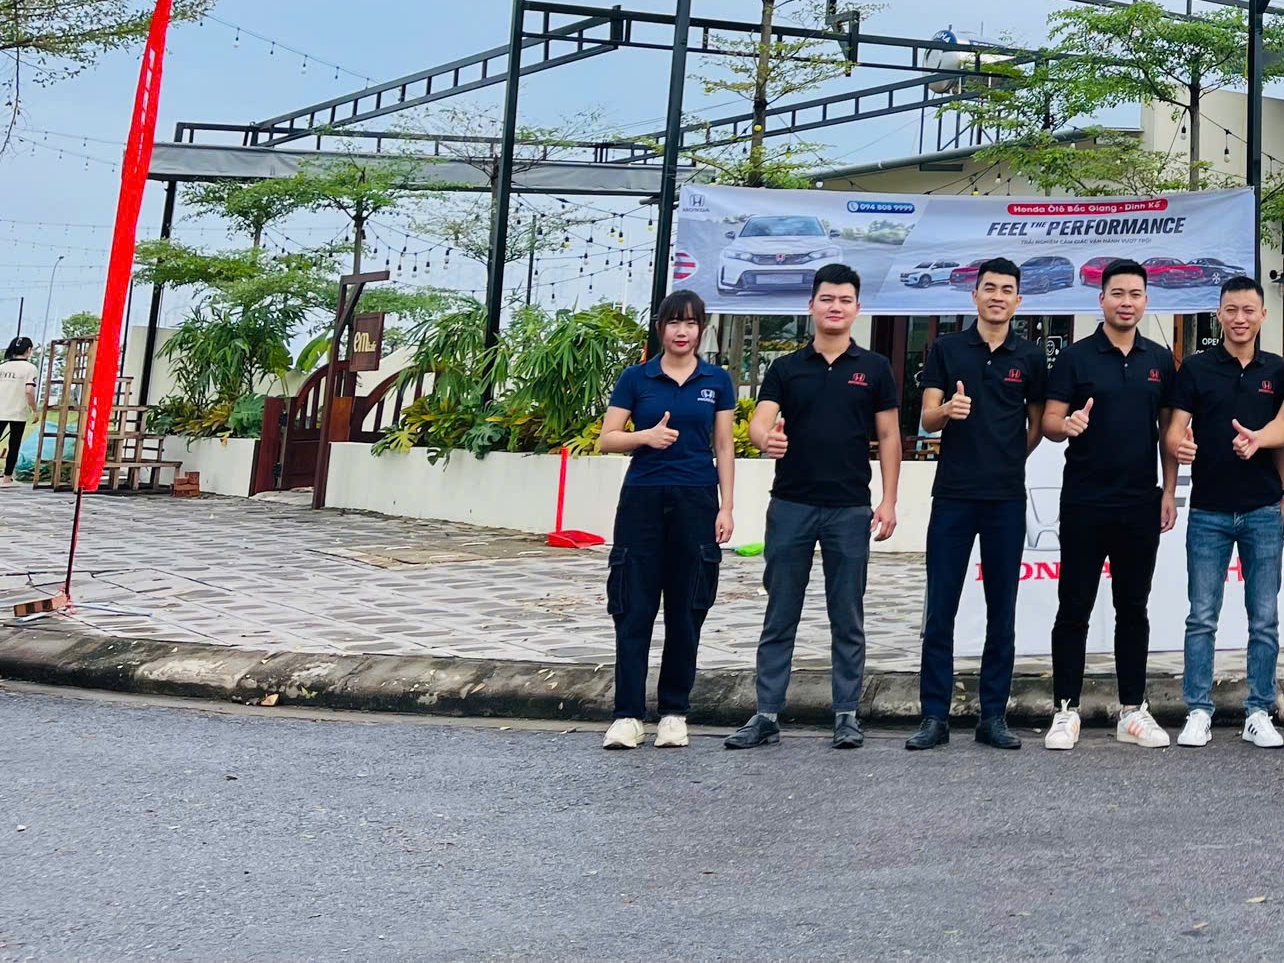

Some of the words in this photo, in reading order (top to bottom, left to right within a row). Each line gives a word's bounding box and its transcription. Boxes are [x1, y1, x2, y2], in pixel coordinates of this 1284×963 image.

[1013, 205, 1046, 213] Honda
[1088, 205, 1117, 213] Giang
[986, 221, 1028, 236] FEEL
[1046, 216, 1187, 236] PERFORMANCE
